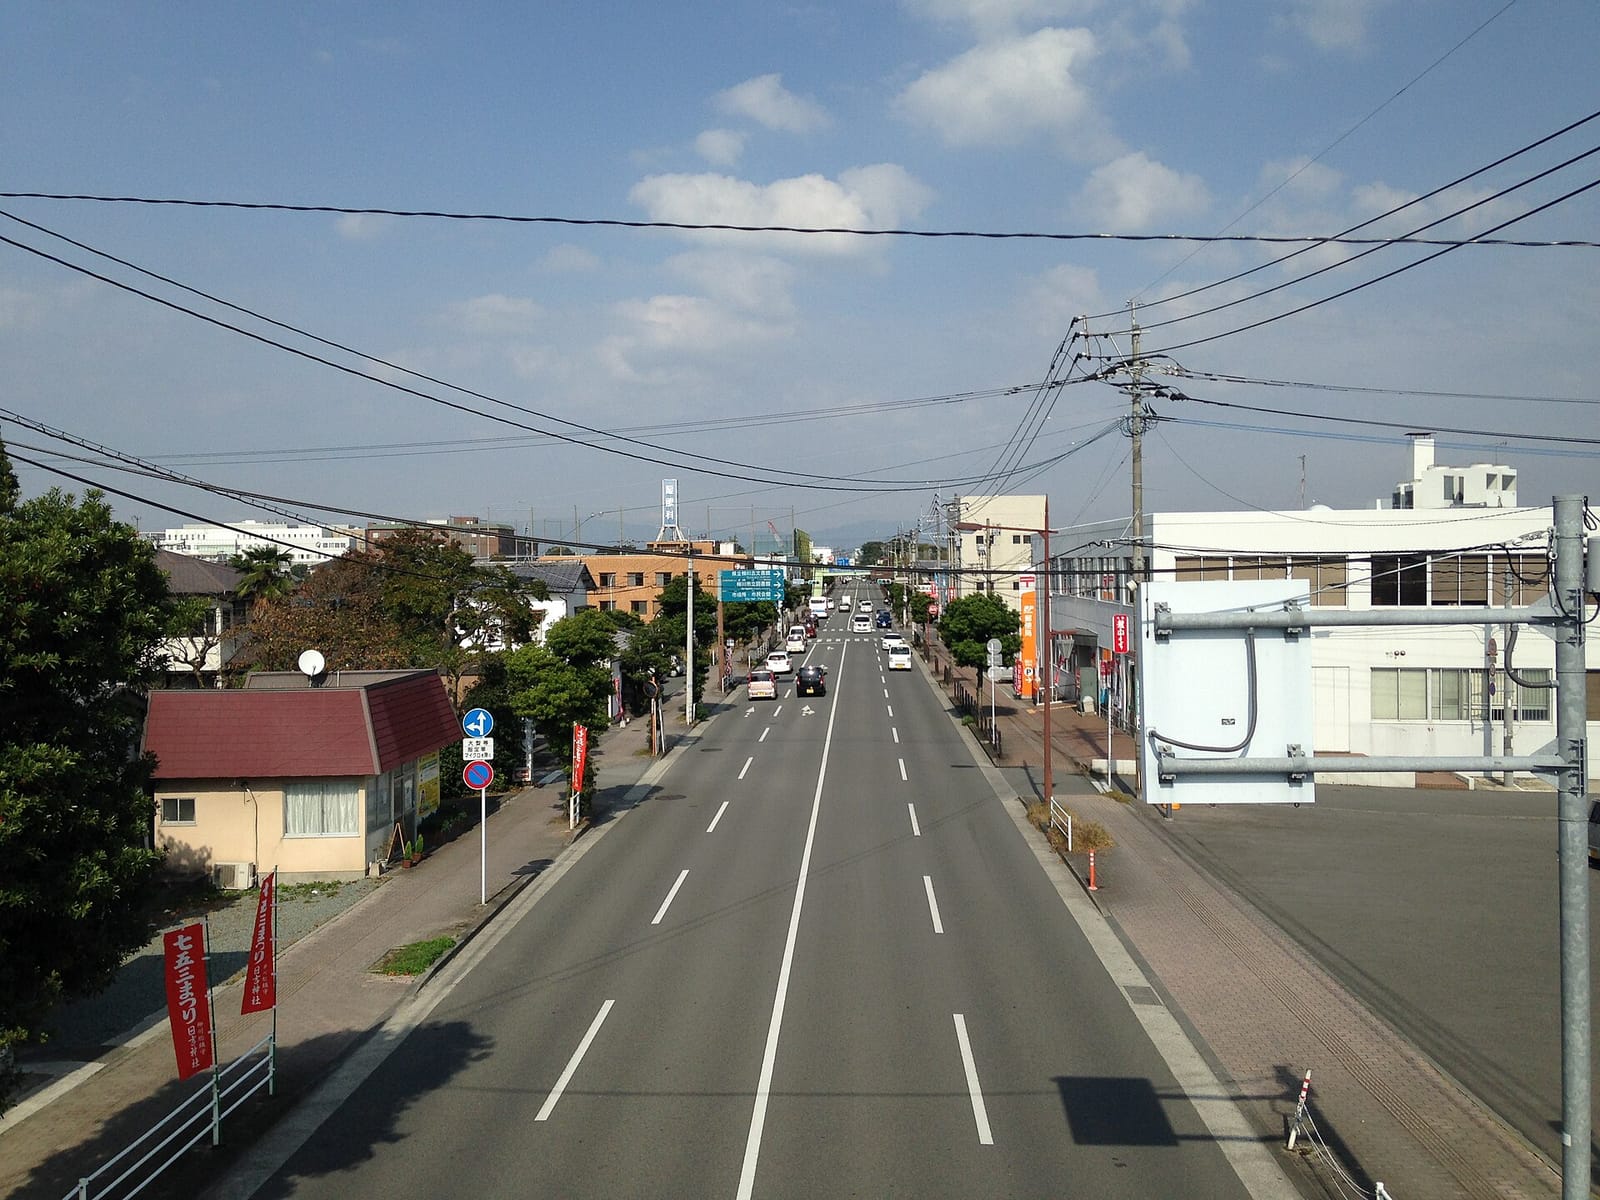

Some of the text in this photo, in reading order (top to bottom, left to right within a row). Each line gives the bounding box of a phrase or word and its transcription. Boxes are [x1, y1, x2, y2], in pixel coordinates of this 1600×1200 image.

[173, 933, 197, 1025] 七五三まつり
